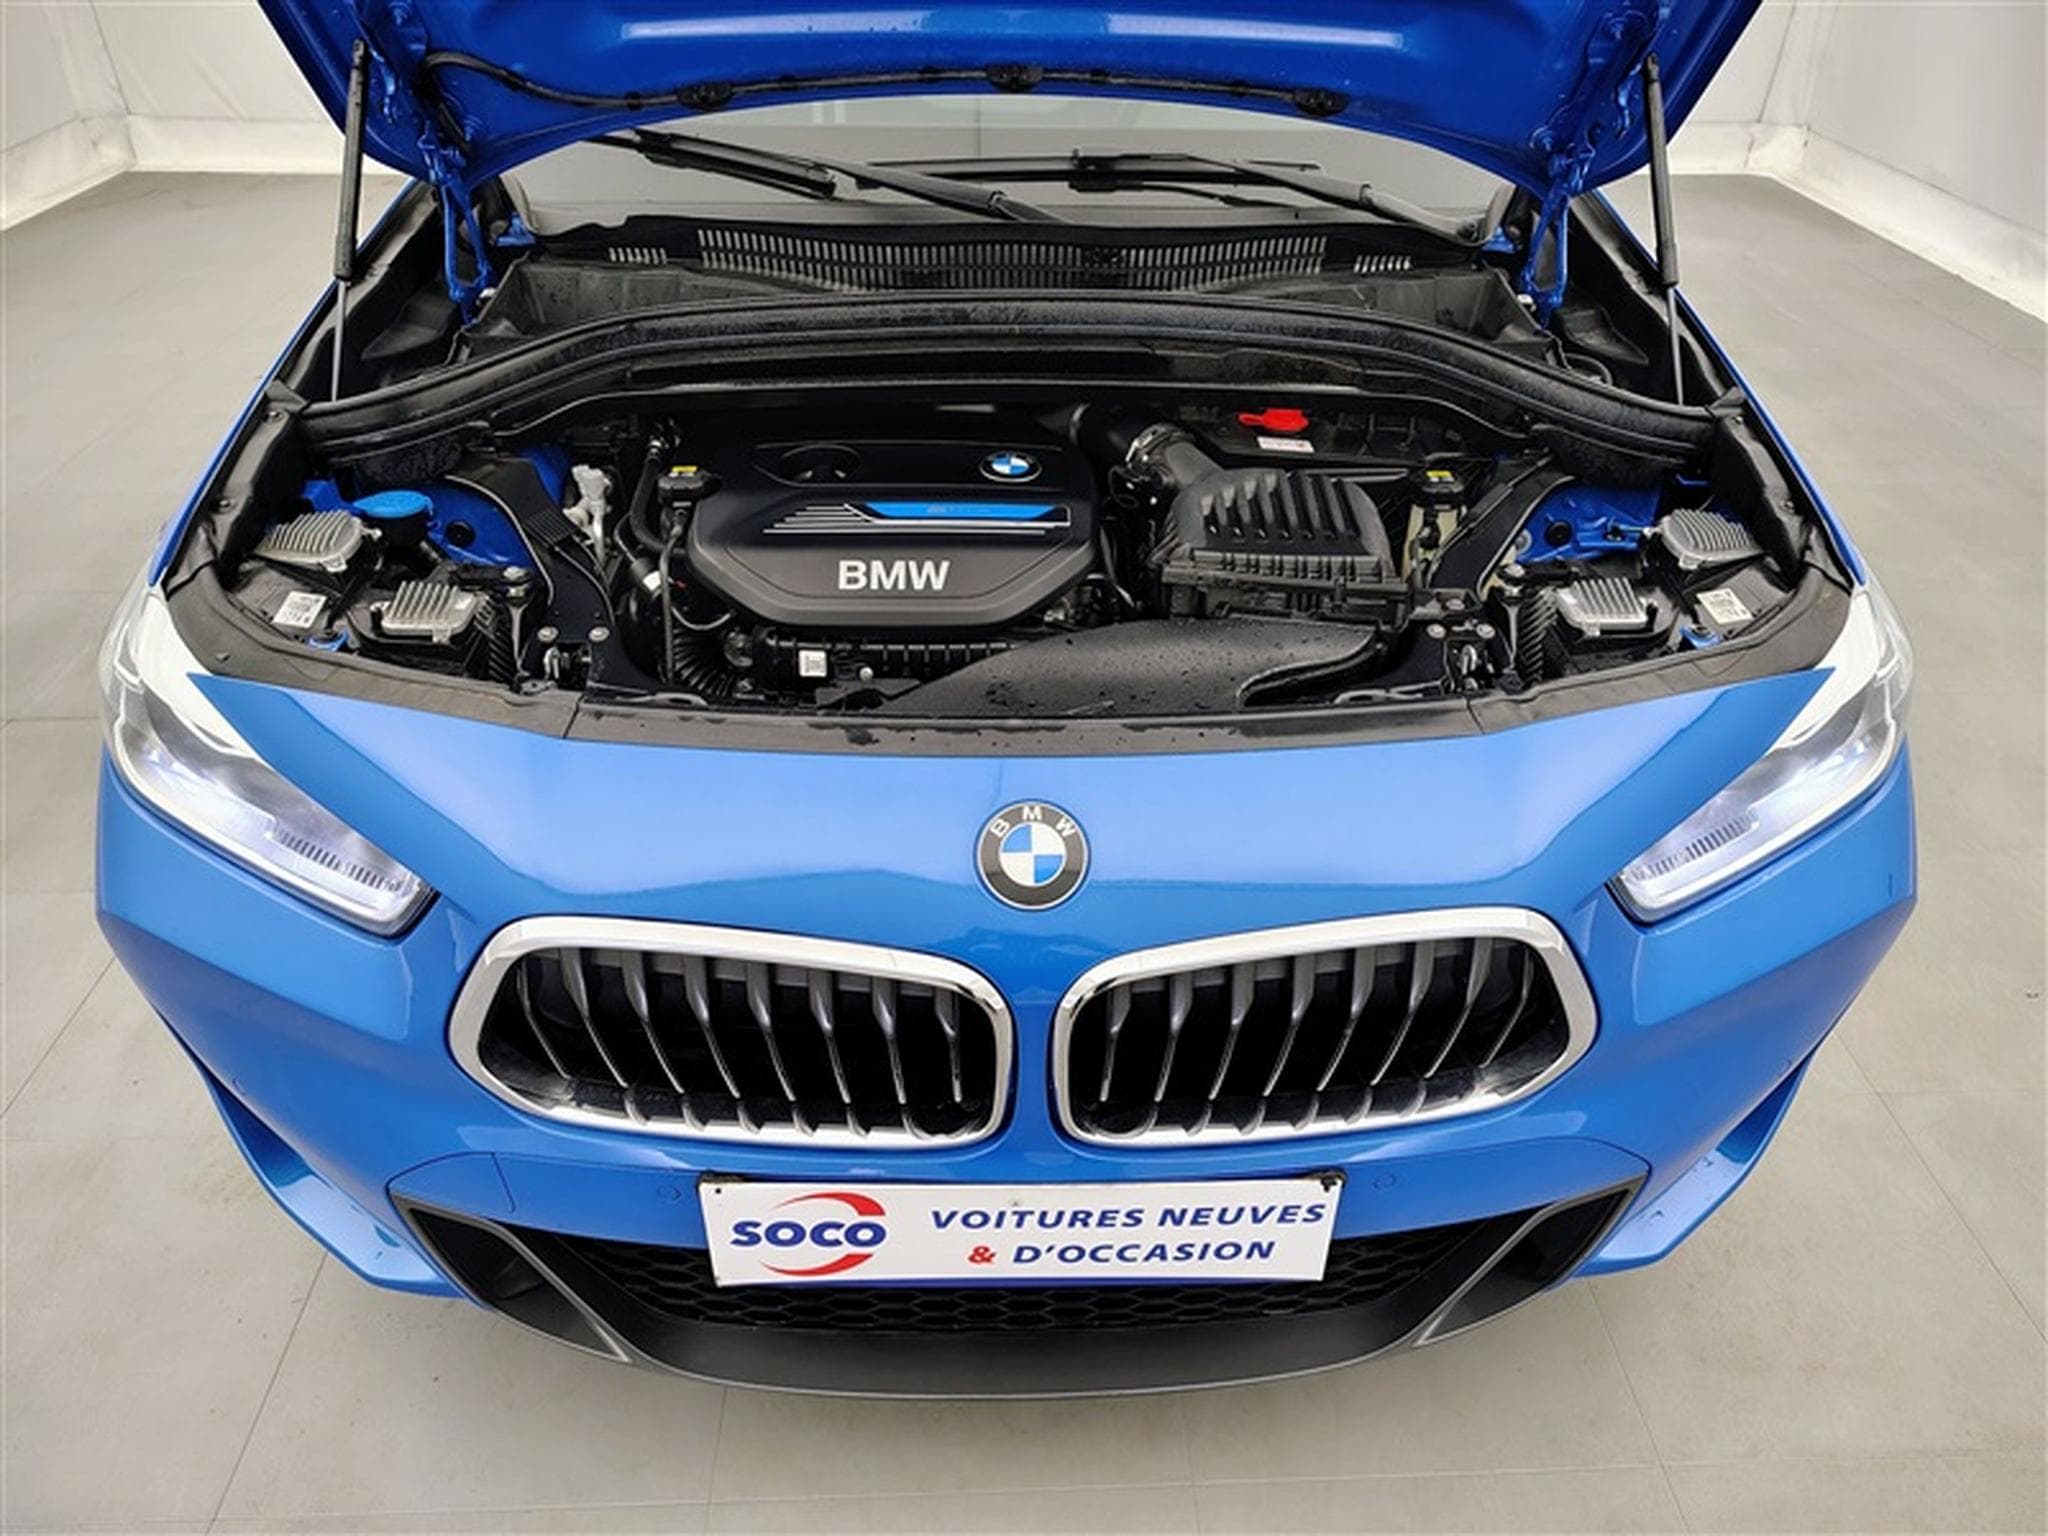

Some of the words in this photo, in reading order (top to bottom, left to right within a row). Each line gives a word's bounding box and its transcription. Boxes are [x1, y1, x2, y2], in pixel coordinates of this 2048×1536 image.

[839, 560, 950, 590] BMW
[990, 805, 1076, 838] BMW
[931, 1208, 1145, 1230] VOITURES
[1157, 1203, 1326, 1227] NEUVES
[730, 1220, 887, 1248] SOCO
[967, 1245, 996, 1265] &
[1012, 1241, 1276, 1264] D'OCCASION
